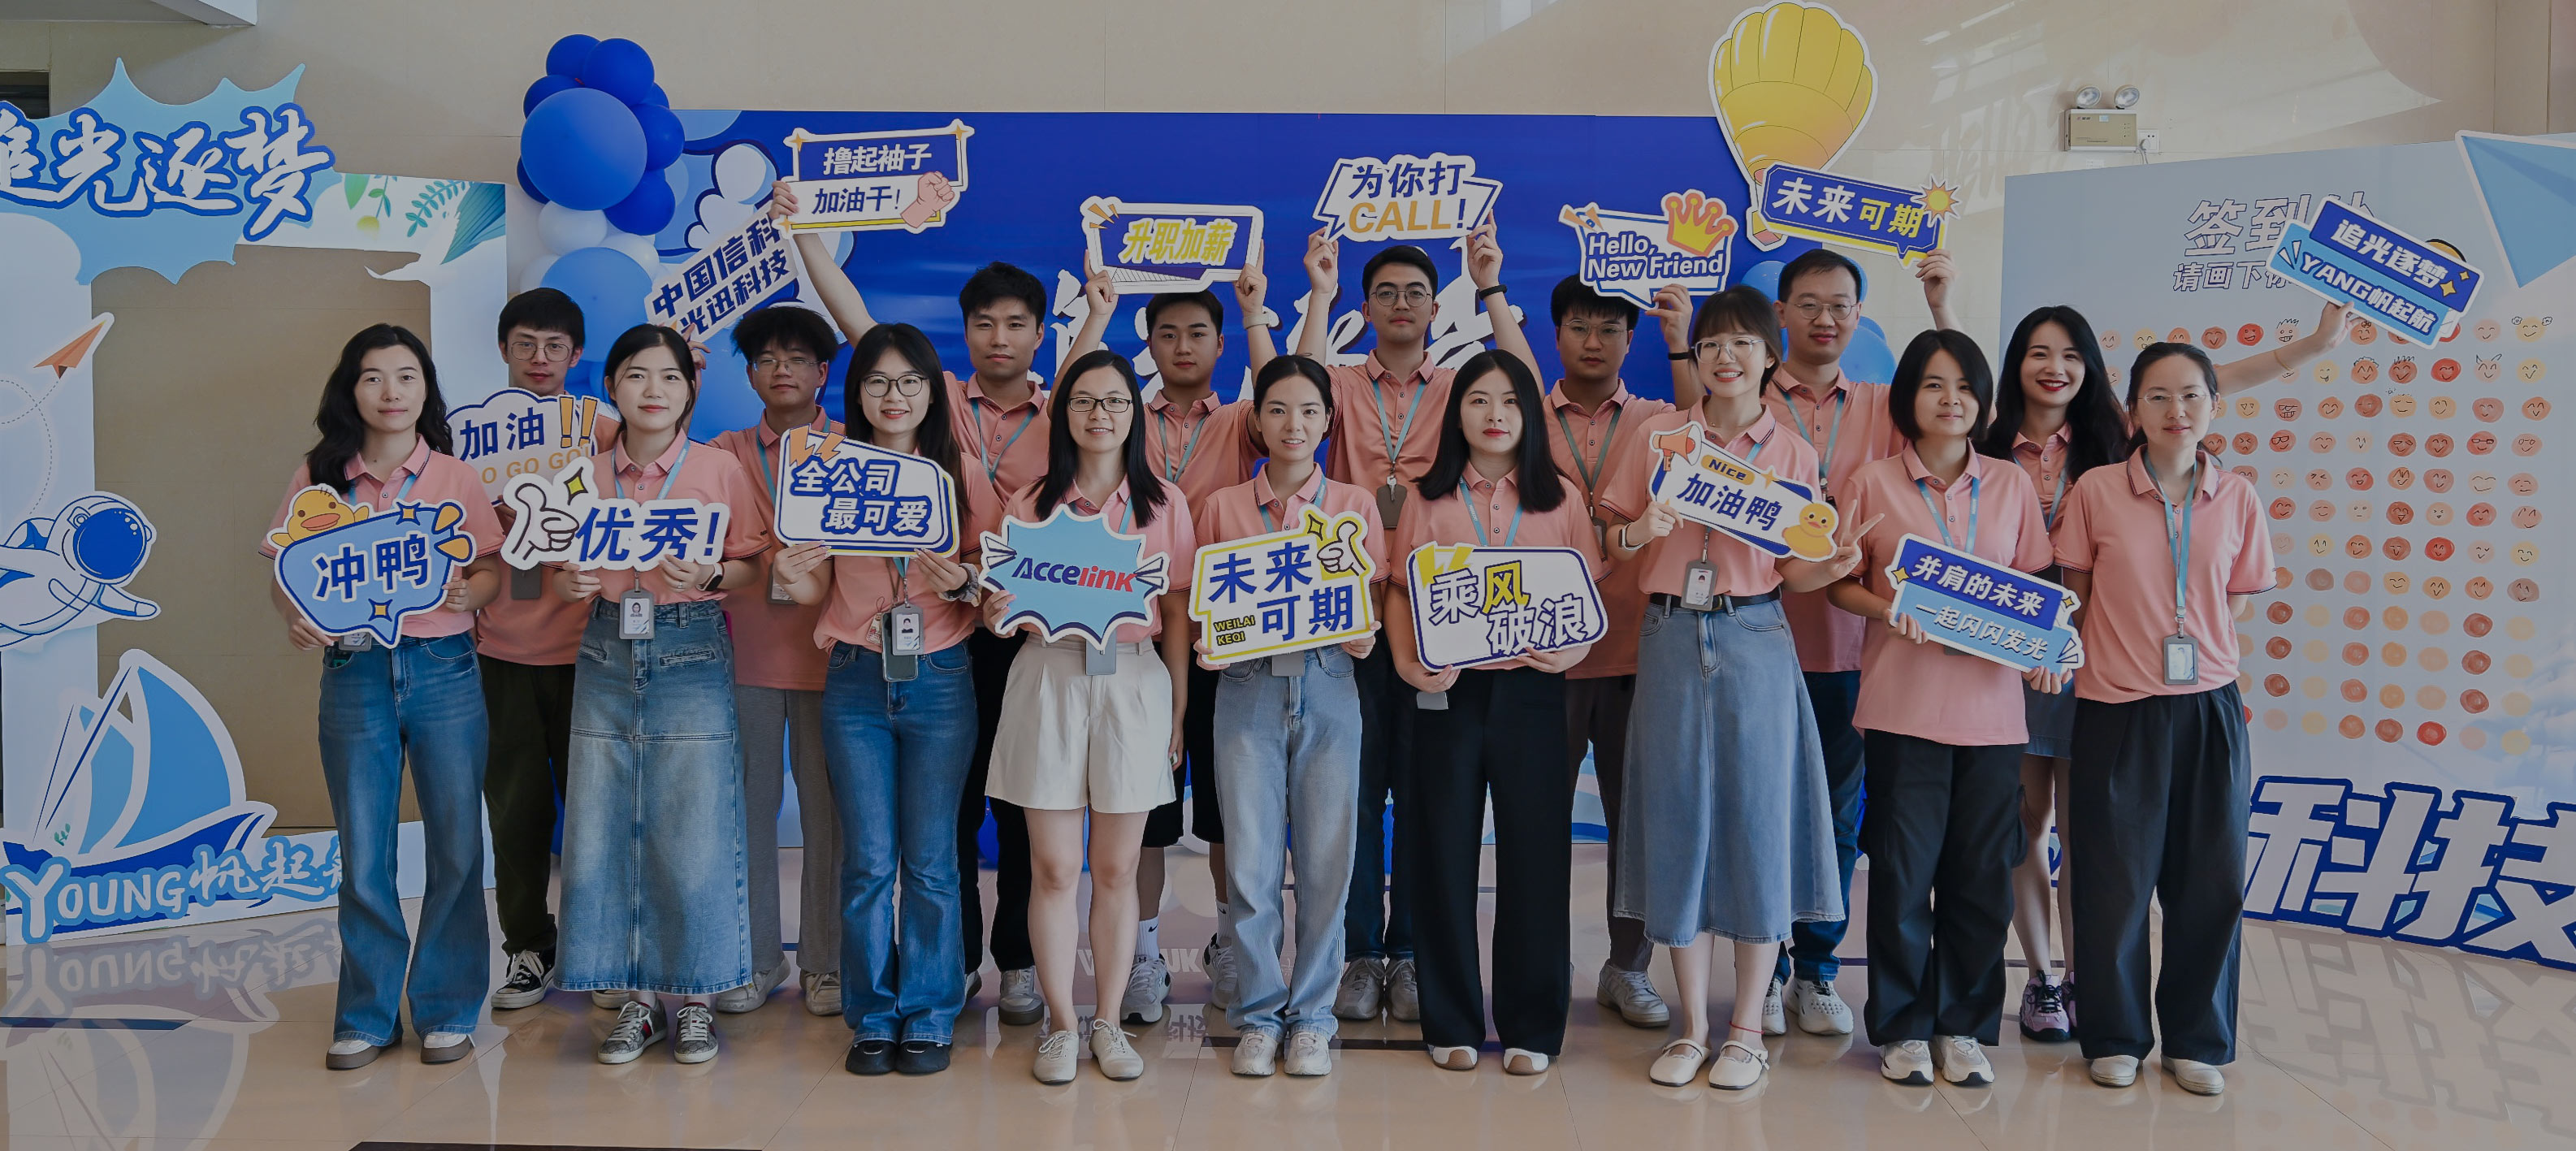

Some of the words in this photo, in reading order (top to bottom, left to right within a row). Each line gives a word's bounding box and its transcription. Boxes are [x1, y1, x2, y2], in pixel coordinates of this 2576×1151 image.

[823, 143, 932, 176] 撸起袖子
[1349, 163, 1466, 198] 为你打
[812, 184, 901, 216] 加油干!
[1349, 198, 1467, 233] CALL!
[1772, 176, 1924, 238] 未来可期
[2184, 191, 2375, 257] 签到
[652, 212, 781, 318] 中国信科
[1122, 219, 1236, 264] 升职加薪
[1587, 257, 1643, 279] New
[1649, 253, 1724, 277] Friend
[1588, 233, 1656, 256] Hello,
[2331, 219, 2449, 288] 追光逐梦
[680, 249, 790, 335] 光迅科技
[2300, 253, 2438, 335] YANG帆起航
[482, 467, 497, 484] O
[794, 461, 897, 494] 全公司
[1708, 459, 1747, 482] Nice
[825, 499, 929, 533] 最可爱
[1677, 473, 1783, 532] 加油鸭
[575, 507, 720, 562] 优秀!
[315, 534, 429, 599] 冲鸭
[1011, 557, 1138, 592] Accelink
[1208, 542, 1313, 604] 未来
[1429, 560, 1531, 626] 乘风
[1911, 554, 2046, 618] 并肩的未来
[1214, 614, 1256, 633] WEILAI
[1217, 630, 1246, 647] KEQI
[1257, 584, 1353, 642] 可期
[1487, 592, 1588, 656] 破浪
[1915, 603, 2049, 661] 一起闪闪发光
[6, 842, 342, 938] YOUNG帆起
